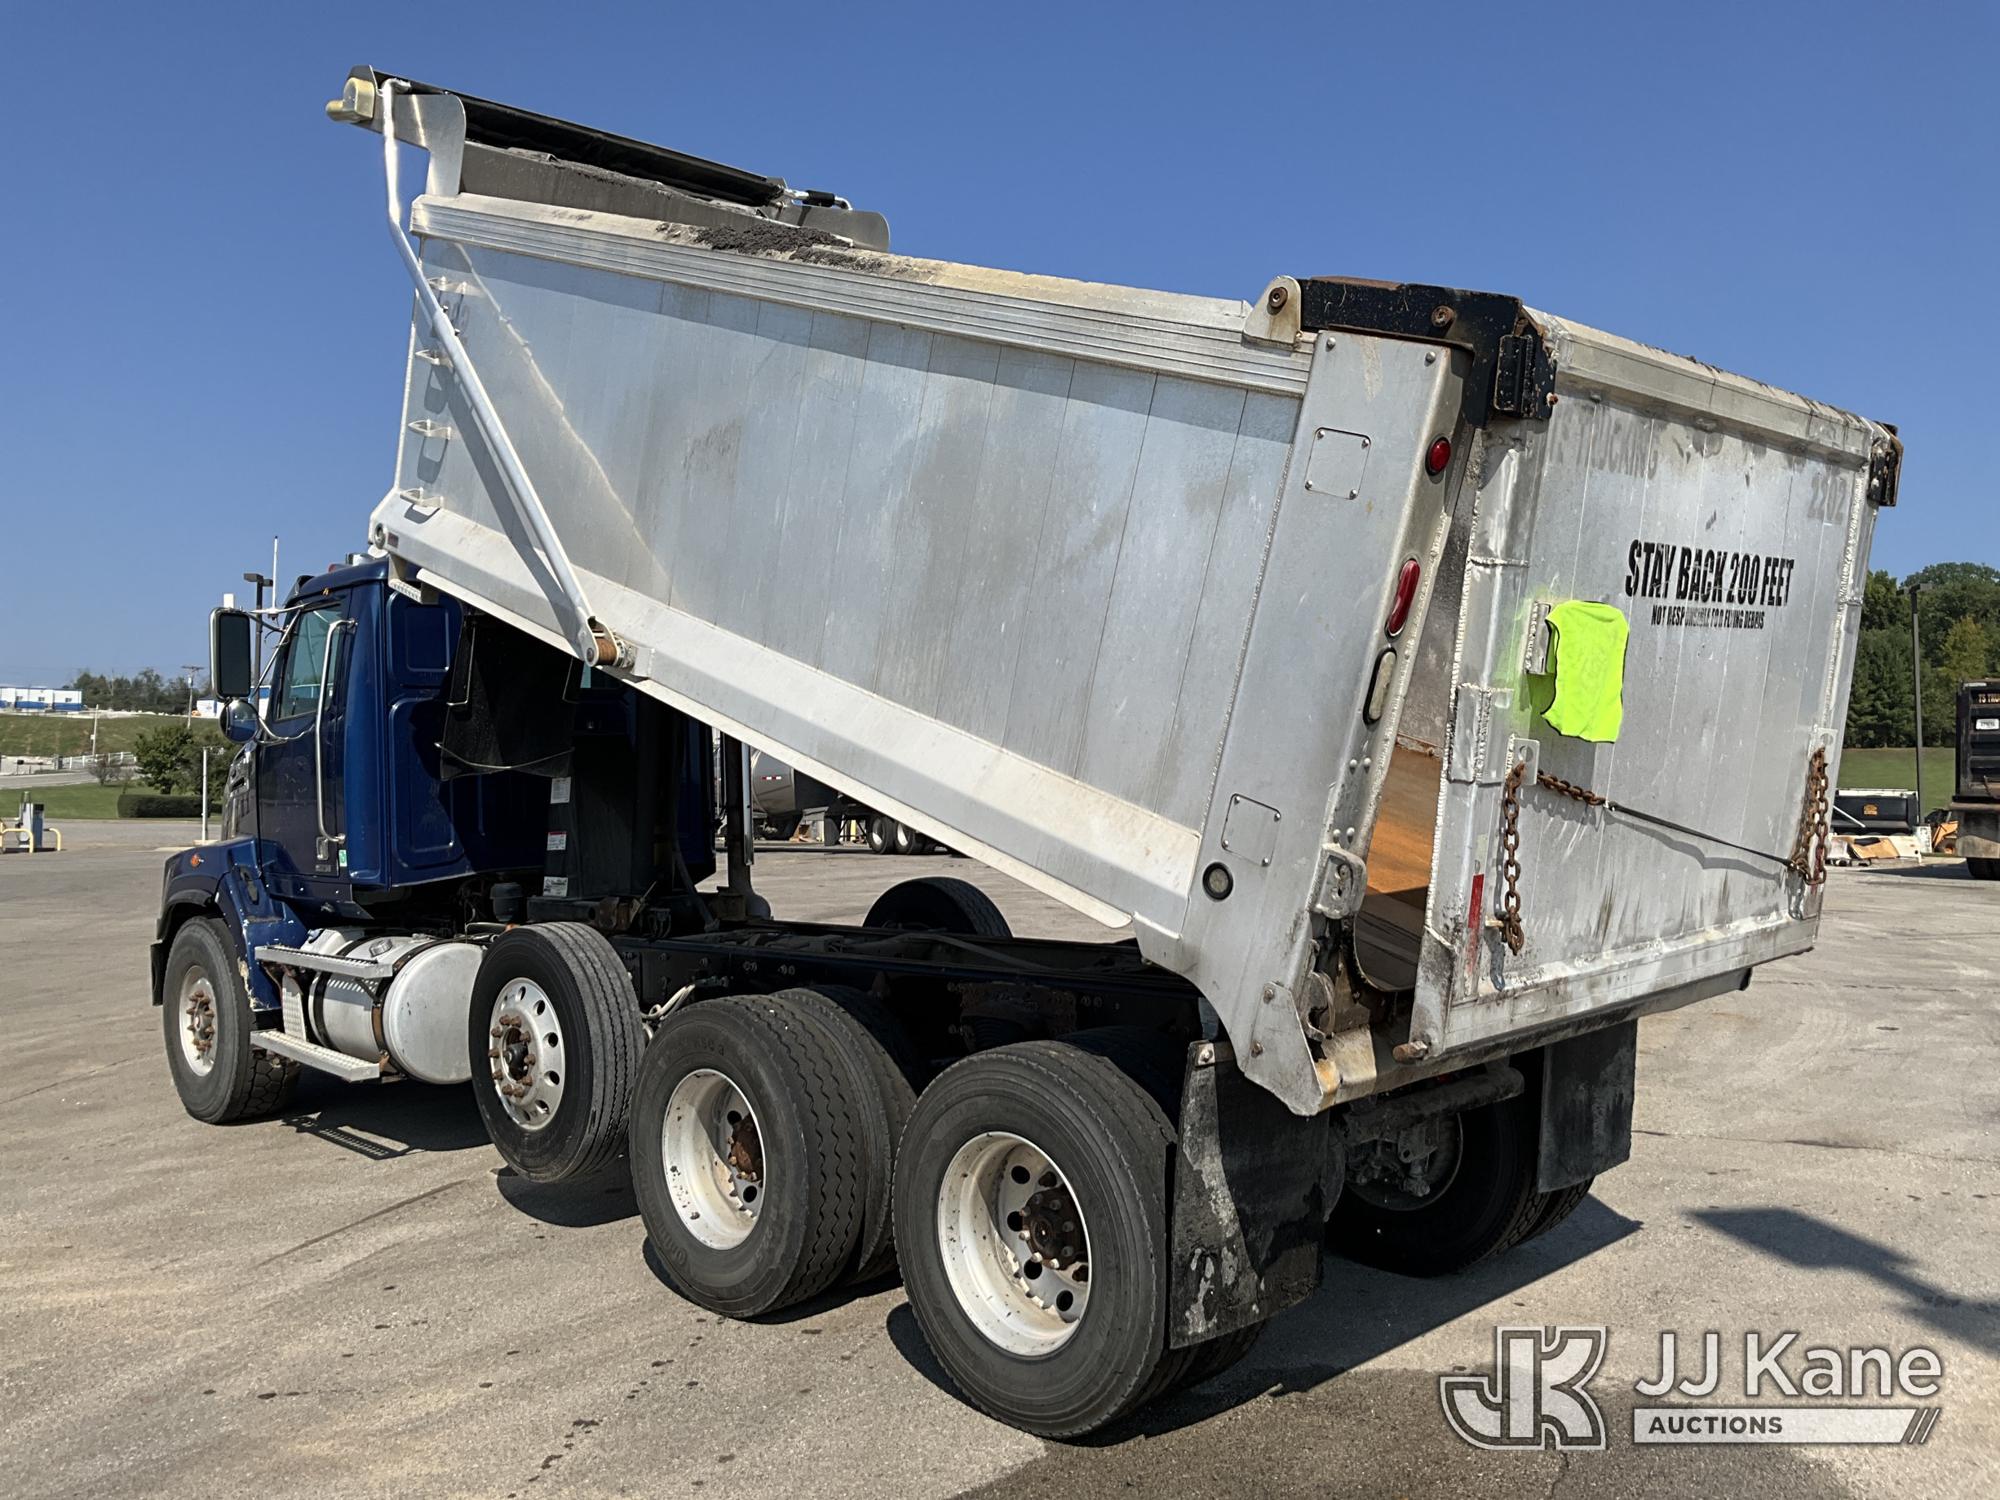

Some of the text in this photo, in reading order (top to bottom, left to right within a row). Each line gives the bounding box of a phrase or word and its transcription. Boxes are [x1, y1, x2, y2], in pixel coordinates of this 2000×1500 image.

[1625, 539, 1795, 606] STAY BACK 200 FEET
[1651, 604, 1667, 626] NOT
[1743, 610, 1765, 629] DEBRIS
